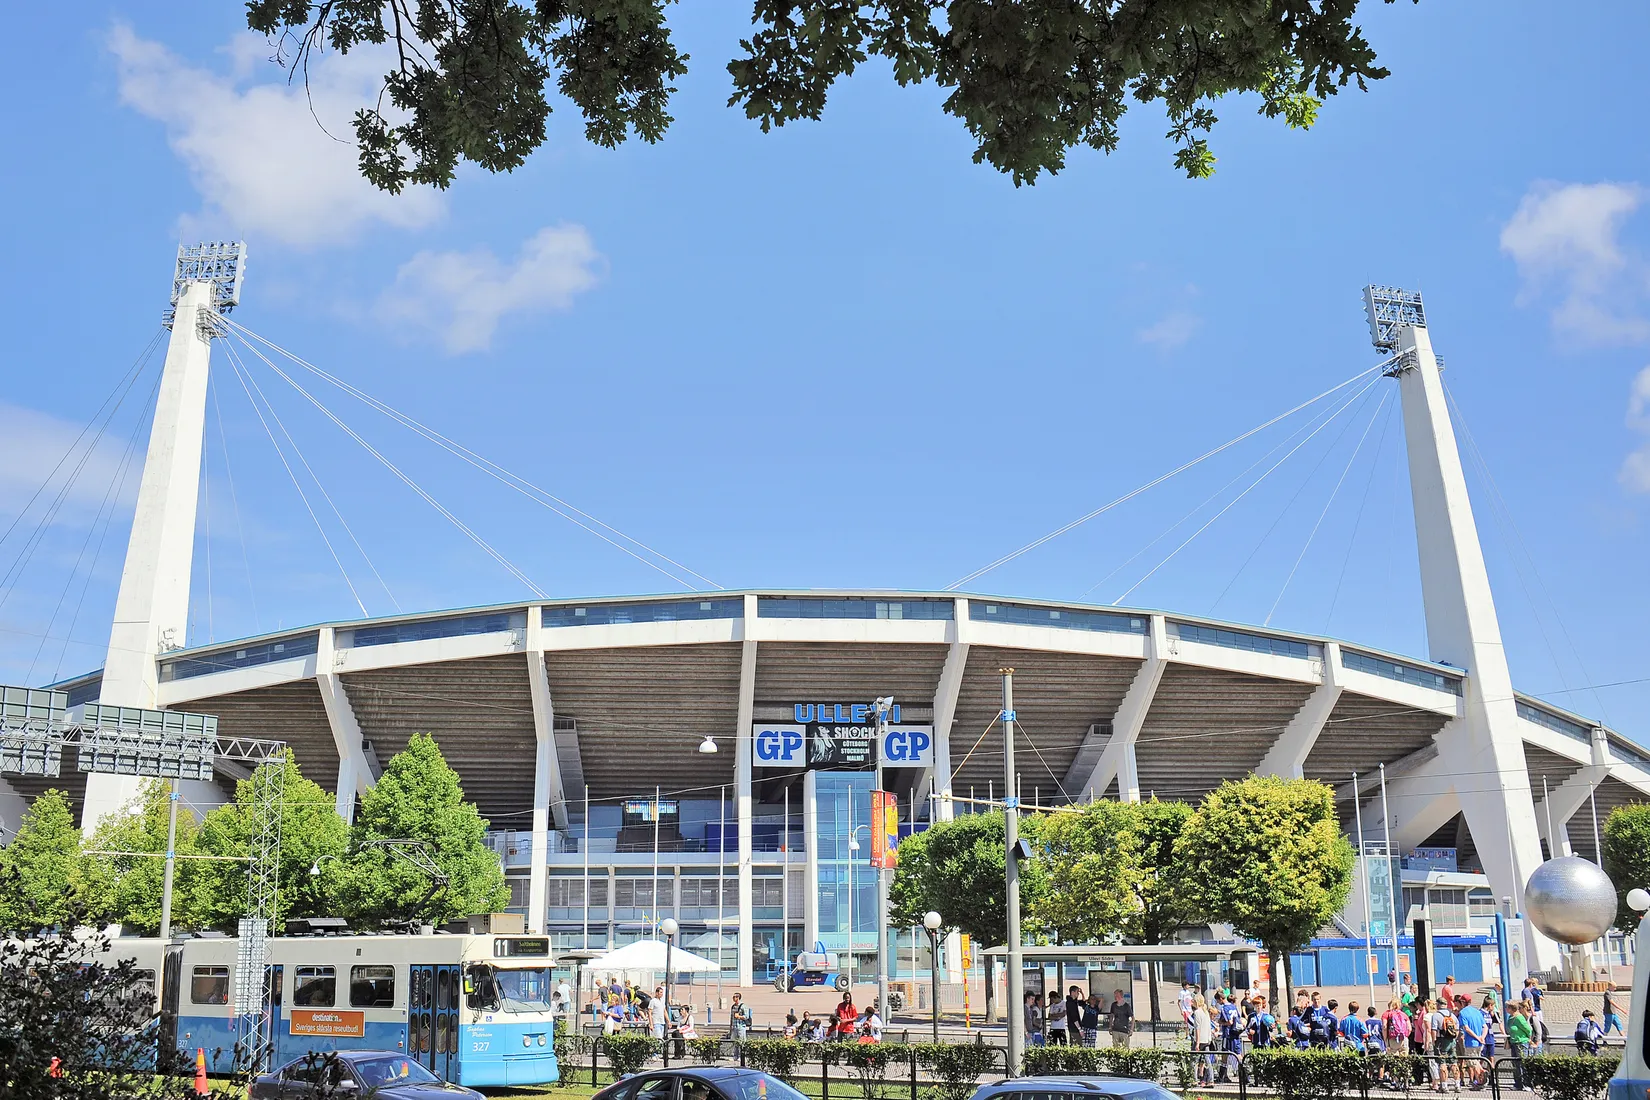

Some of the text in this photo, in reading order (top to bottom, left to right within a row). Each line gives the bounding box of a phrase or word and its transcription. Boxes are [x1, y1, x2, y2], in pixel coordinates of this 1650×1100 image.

[834, 727, 875, 739] SHOCK
[756, 730, 803, 760] GP
[884, 731, 930, 761] GP
[495, 939, 508, 957] 11
[472, 1041, 490, 1052] 327
